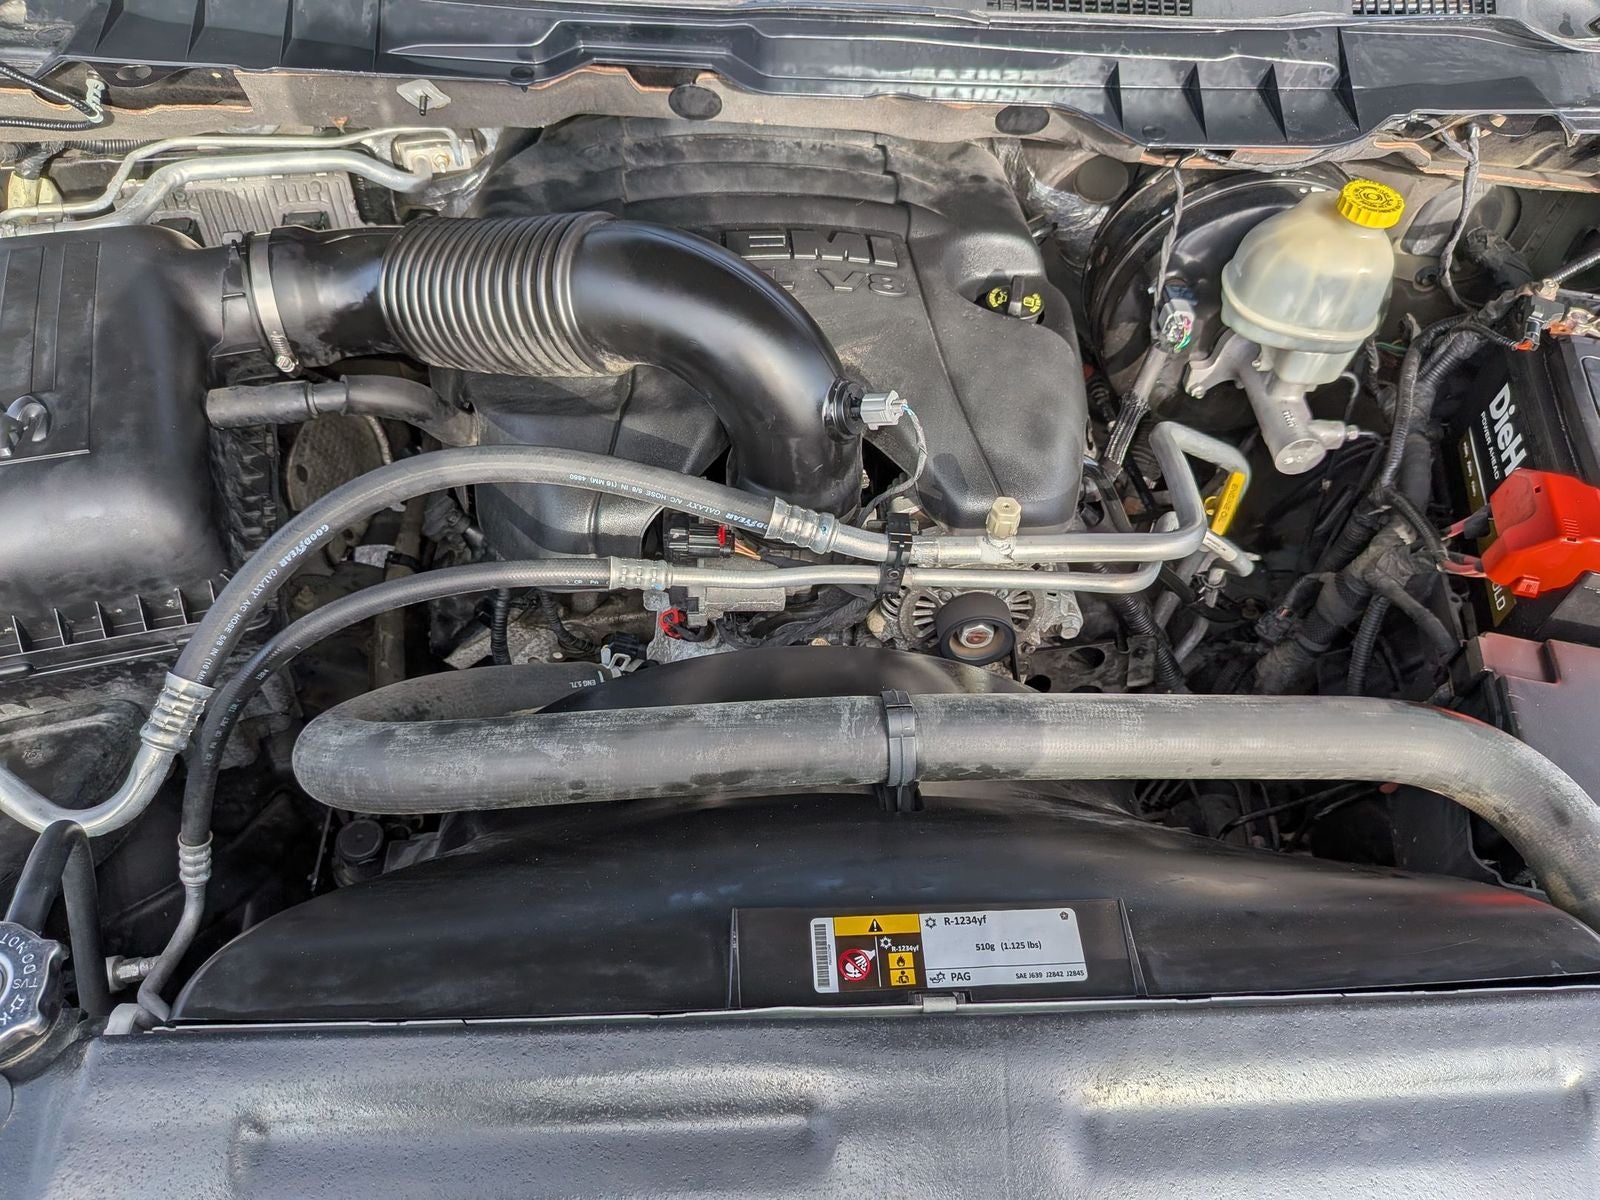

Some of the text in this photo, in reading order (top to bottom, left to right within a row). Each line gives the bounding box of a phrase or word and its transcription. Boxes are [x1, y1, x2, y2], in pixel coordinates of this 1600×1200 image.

[814, 268, 907, 297] V8
[1480, 410, 1500, 480] POWER AHEAD
[646, 490, 668, 500] HOSE
[686, 502, 721, 515] GALAXY
[278, 524, 329, 568] GOODYEAR
[251, 568, 278, 598] GALAXY
[225, 613, 242, 634] HOSE
[210, 647, 219, 657] IN
[583, 679, 597, 687] ENG
[943, 915, 987, 926] R-1234yf
[891, 944, 920, 953] R-1234yf
[975, 940, 1042, 951] 510g (1.125 lbs)
[950, 971, 971, 982] PAG
[1015, 970, 1085, 980] SAE J639 J2842 J2845
